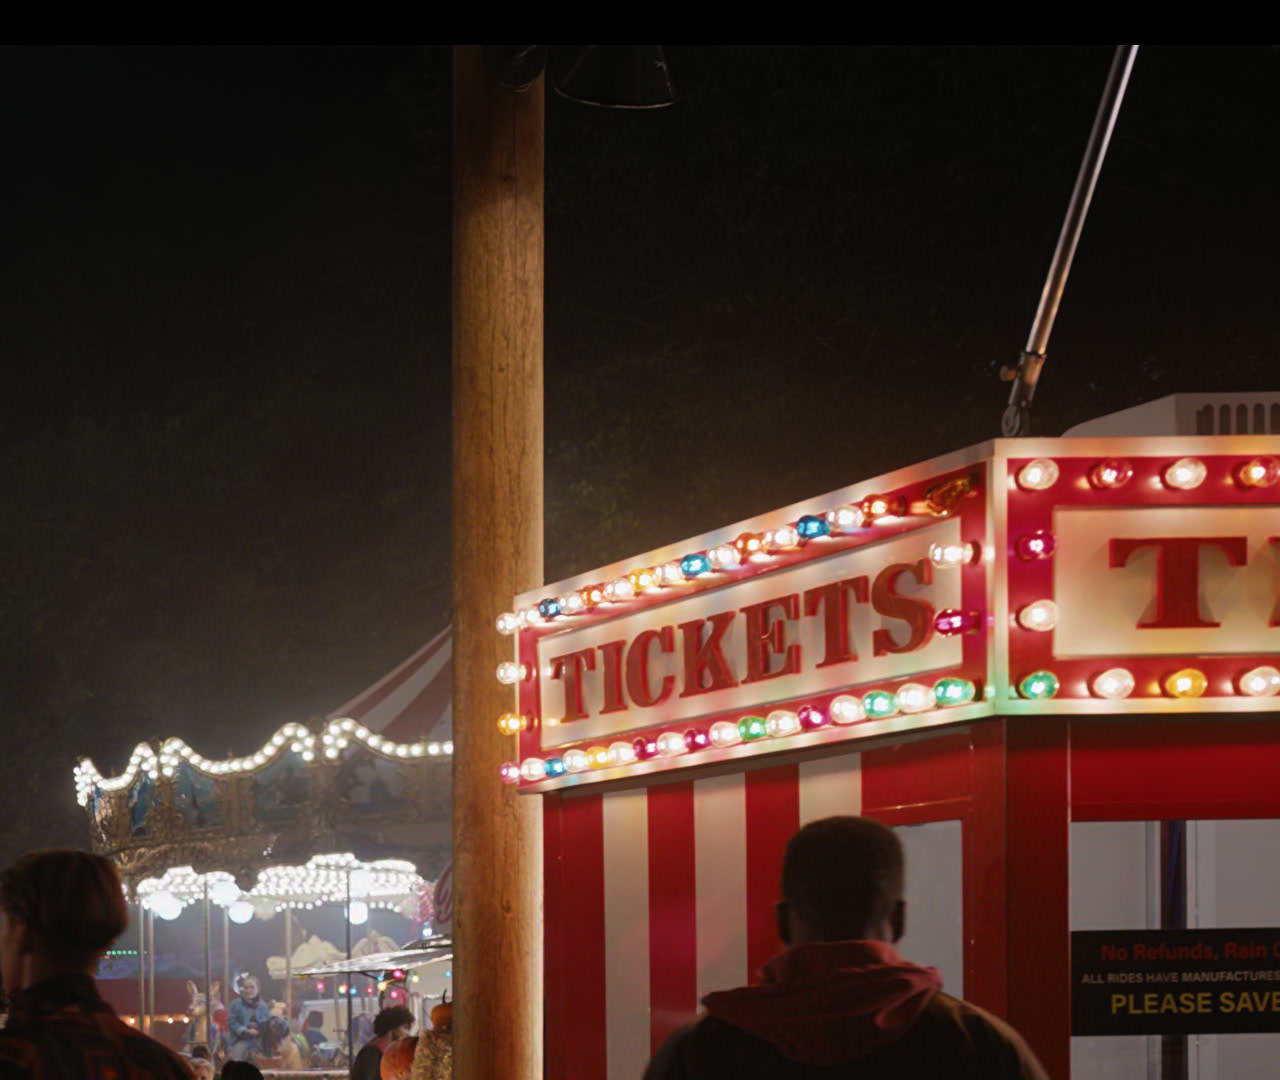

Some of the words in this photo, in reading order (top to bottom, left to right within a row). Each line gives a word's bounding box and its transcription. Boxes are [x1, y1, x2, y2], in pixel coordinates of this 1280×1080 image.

[1109, 537, 1280, 630] T
[551, 559, 933, 725] TICKETS
[1101, 944, 1128, 962] No
[1224, 941, 1267, 960] Rain
[1081, 973, 1104, 985] ALL
[1107, 973, 1143, 984] RIDES
[1146, 971, 1179, 984] HAVE
[1111, 992, 1213, 1016] PLEASE
[1219, 991, 1280, 1014] SAVE
